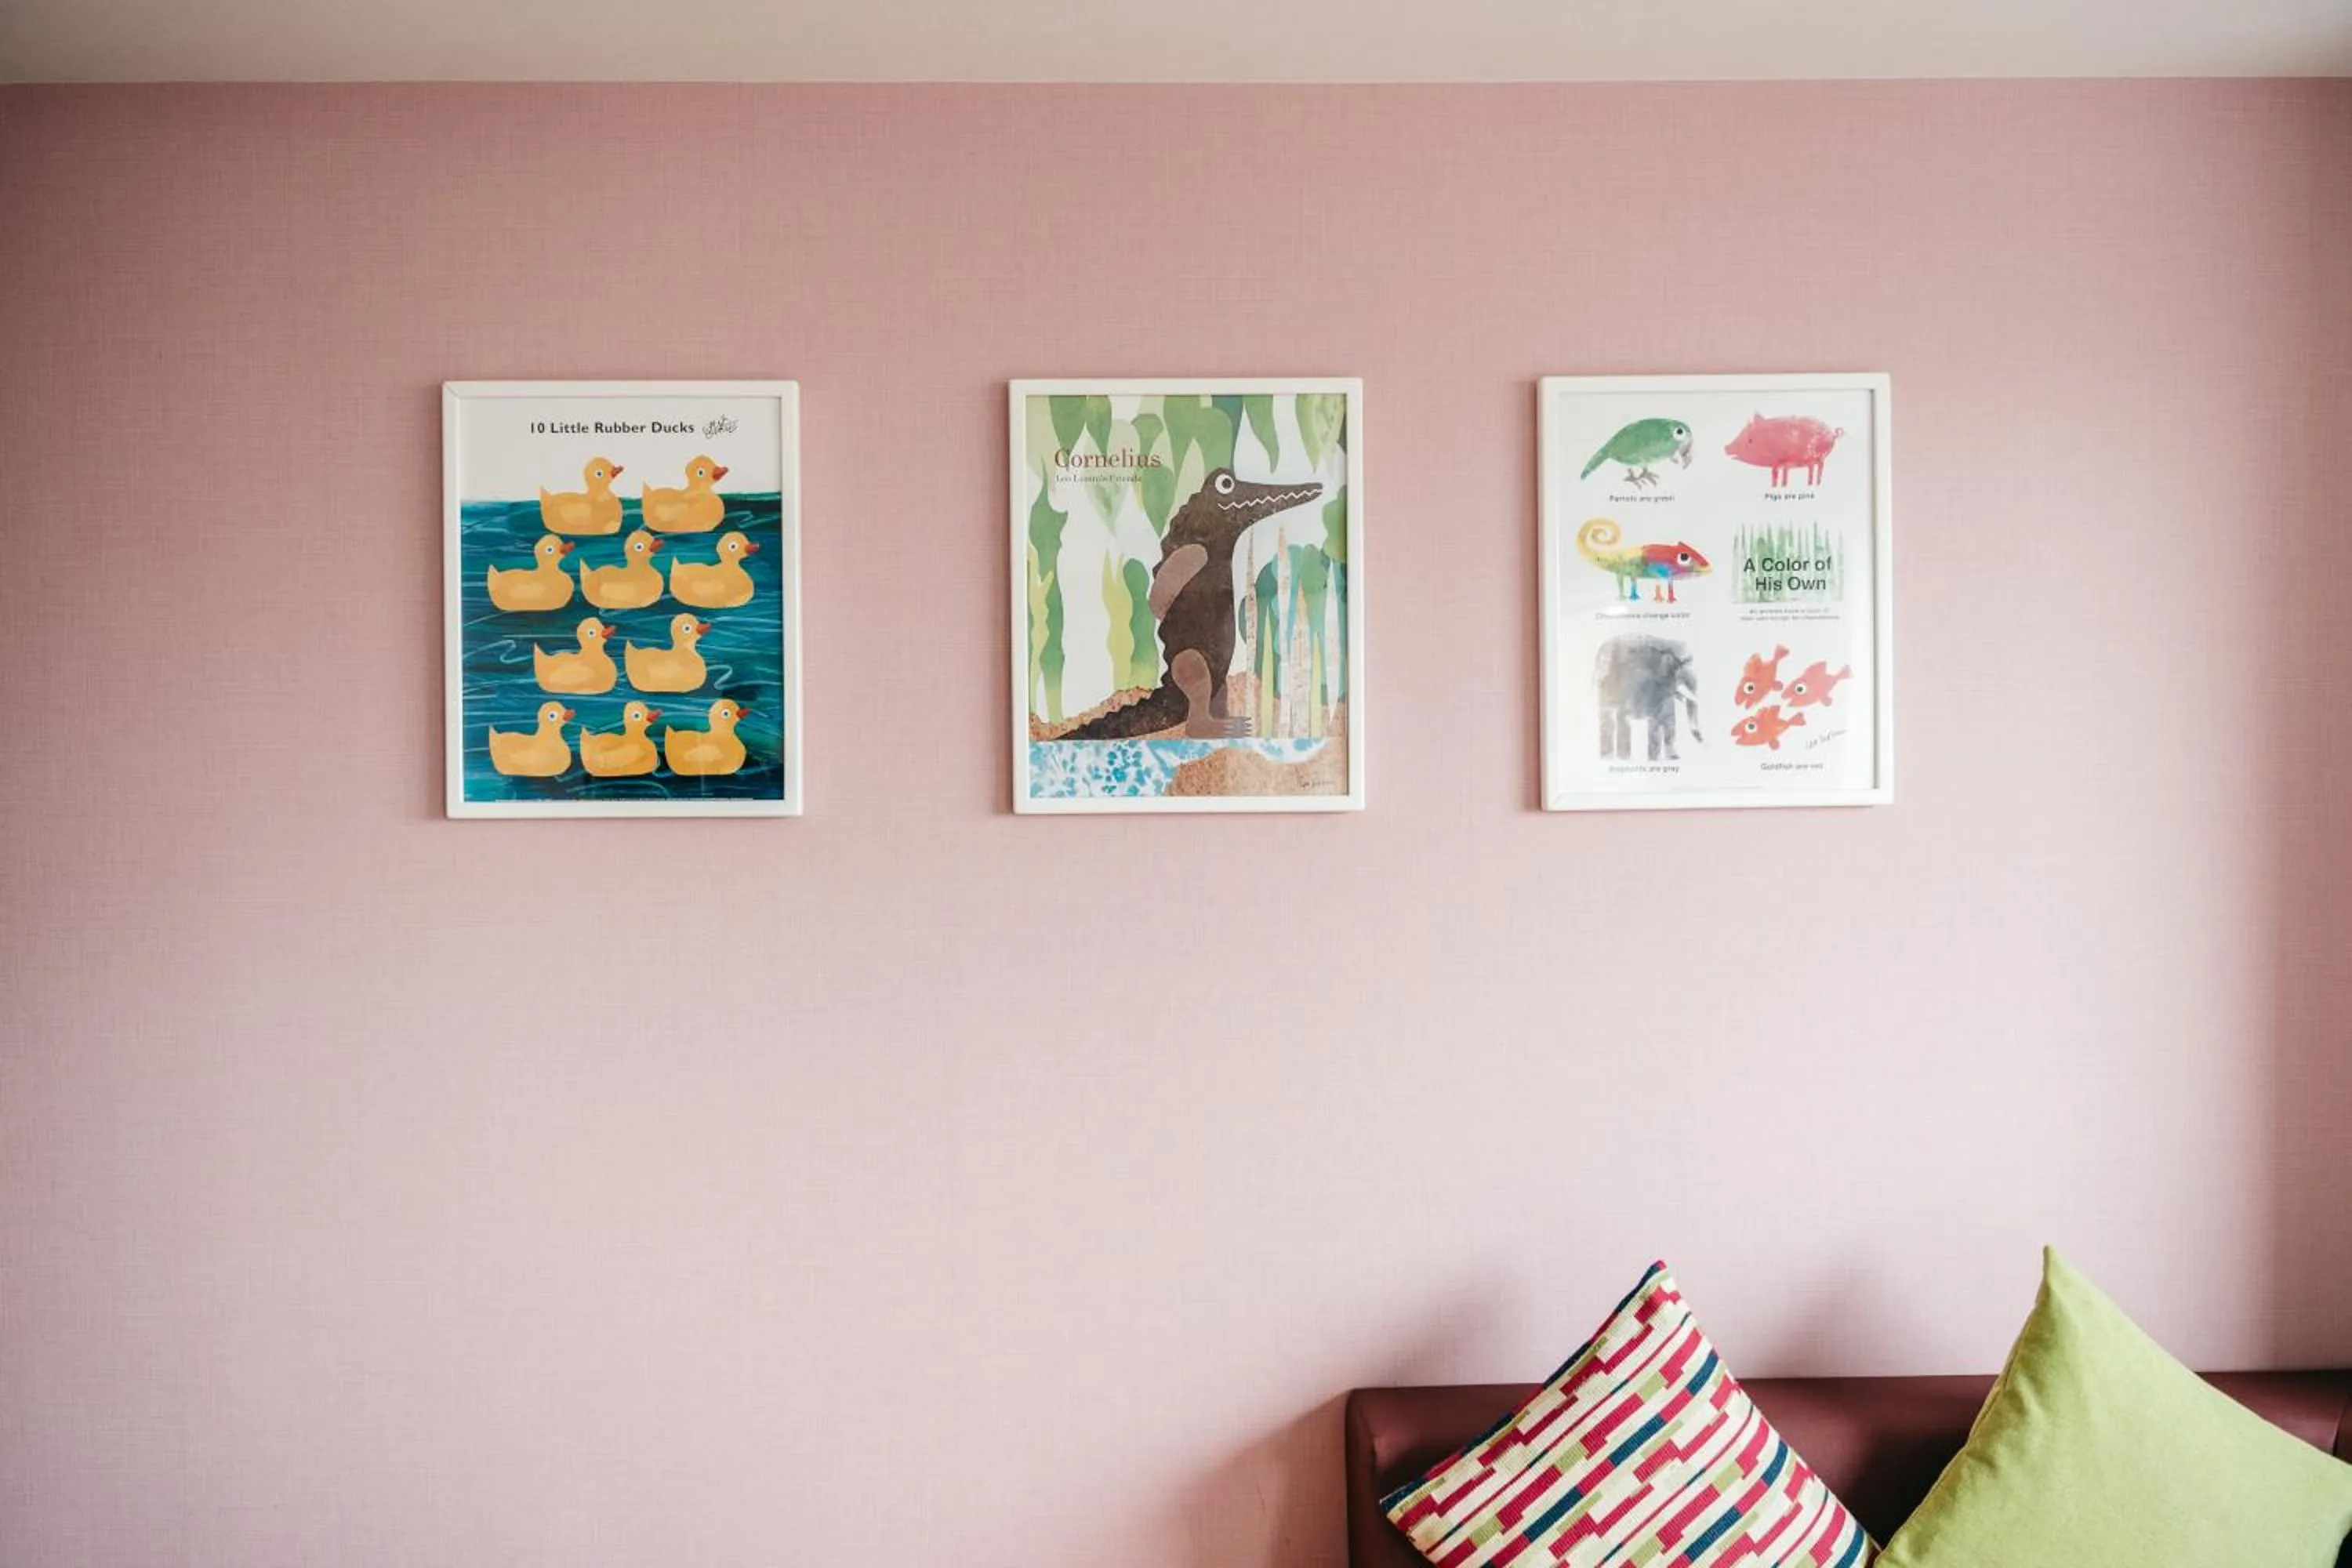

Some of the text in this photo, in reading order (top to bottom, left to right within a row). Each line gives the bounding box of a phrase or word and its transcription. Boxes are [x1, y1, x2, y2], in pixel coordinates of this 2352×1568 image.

[530, 422, 545, 434] 10
[550, 421, 589, 434] Little
[594, 421, 646, 434] Rubber
[652, 421, 695, 434] Ducks
[1054, 448, 1161, 469] Cornelius
[1743, 556, 1832, 572] A Color of
[1756, 576, 1826, 591] His Own
